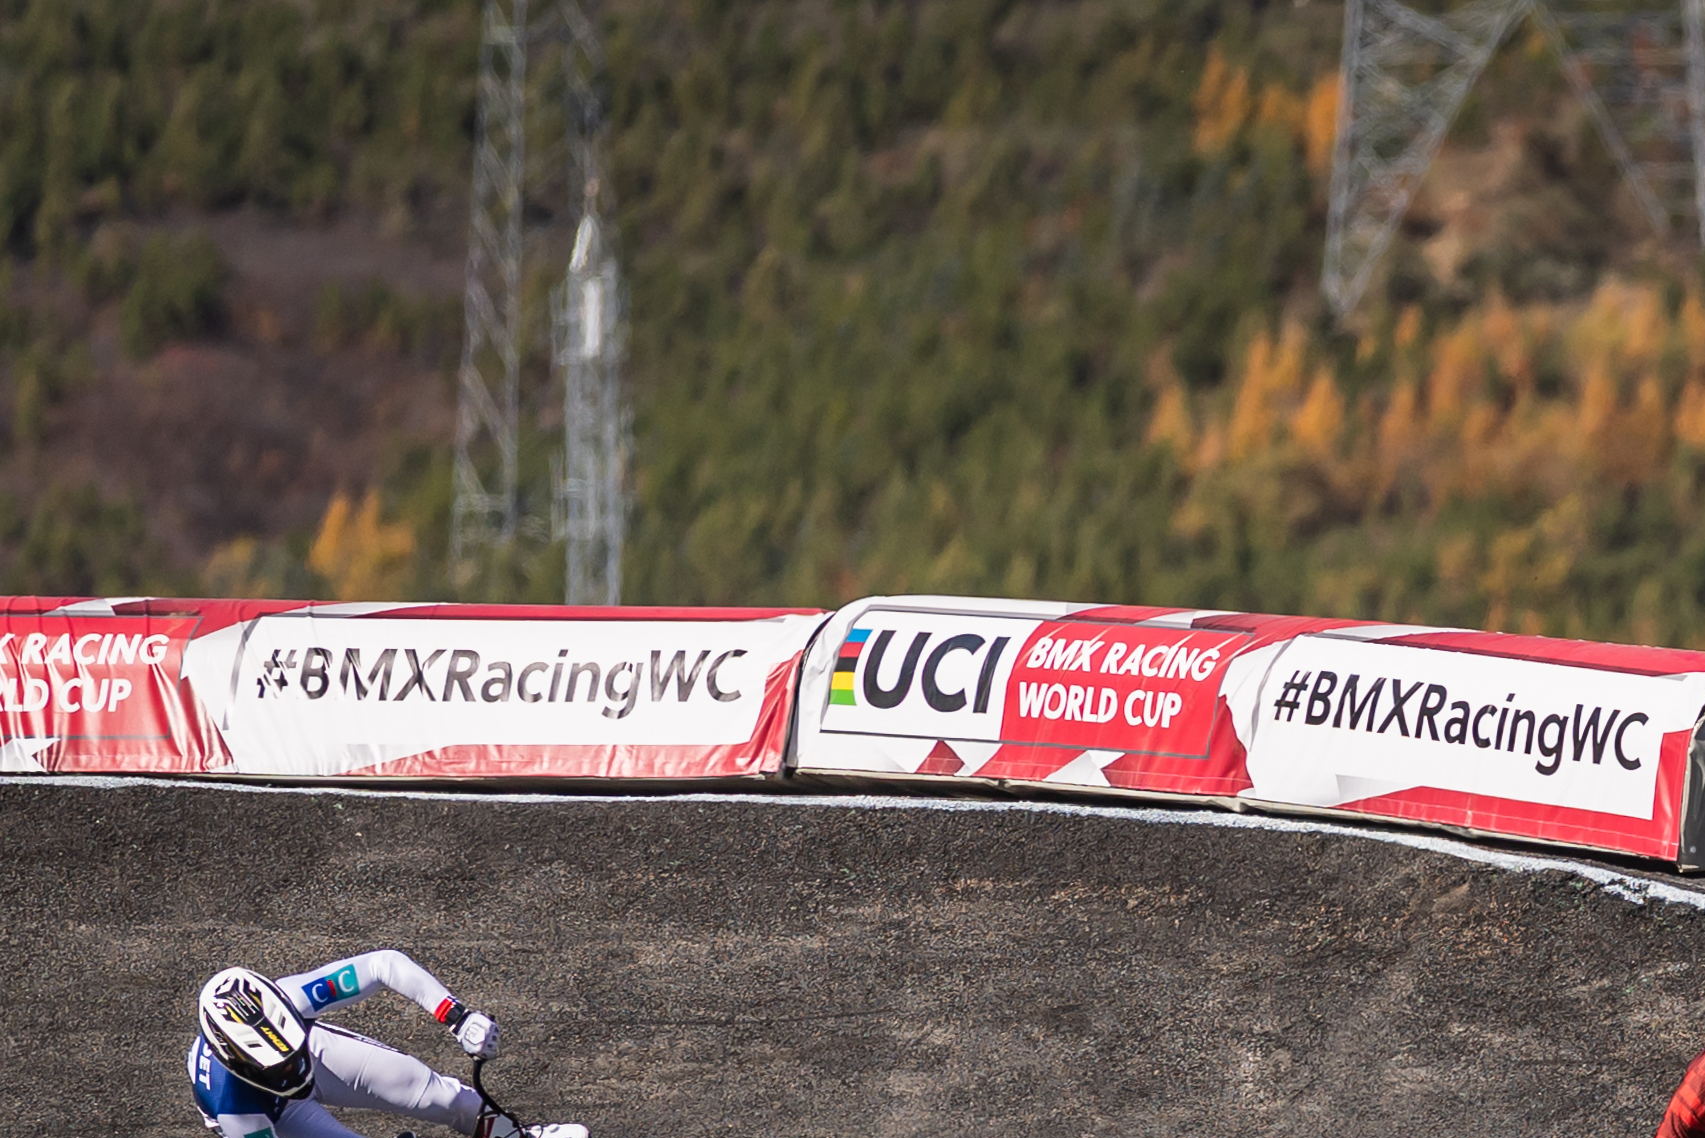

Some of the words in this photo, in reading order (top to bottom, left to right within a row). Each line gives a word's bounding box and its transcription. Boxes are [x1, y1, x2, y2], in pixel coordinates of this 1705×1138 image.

[21, 633, 170, 666] RACING
[861, 629, 1011, 714] UCI
[1026, 635, 1102, 673] BMX
[1103, 638, 1220, 682] RACING
[58, 678, 132, 713] CUP
[255, 646, 749, 720] #BMXRacingWC
[1017, 681, 1124, 724] WORLD
[1126, 688, 1183, 730] CUP
[1273, 668, 1650, 776] #BMXRacingWC
[311, 967, 355, 1004] CIC
